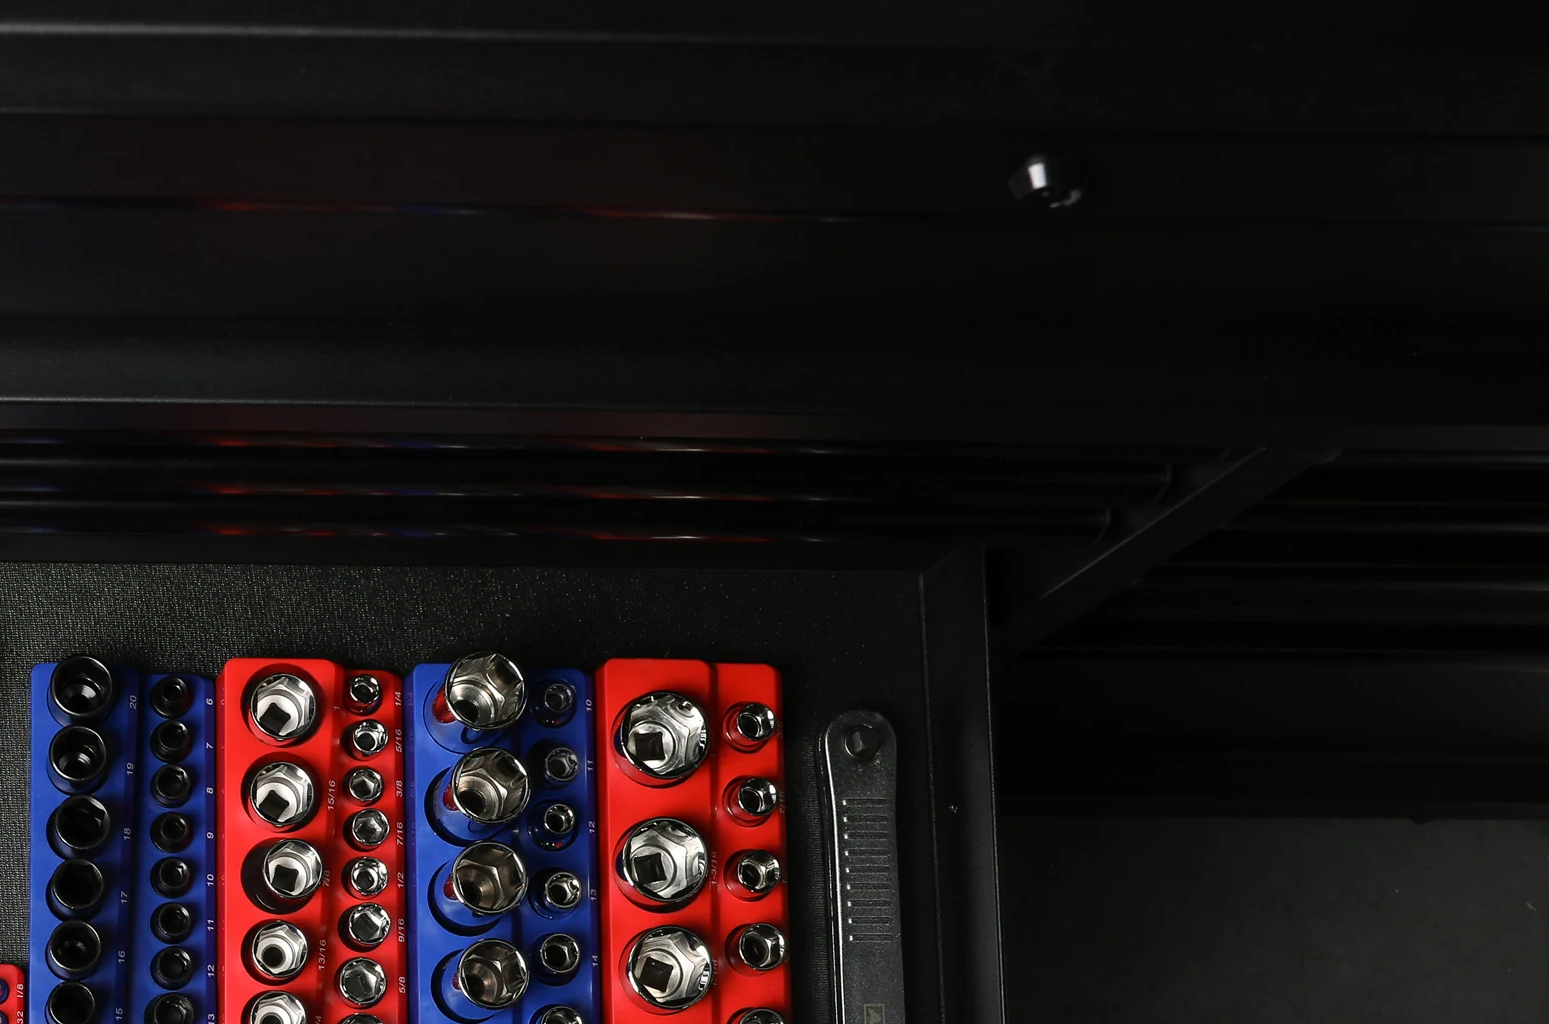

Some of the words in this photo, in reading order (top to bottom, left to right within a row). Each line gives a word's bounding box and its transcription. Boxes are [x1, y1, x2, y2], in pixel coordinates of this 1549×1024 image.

[130, 695, 137, 710] 20
[395, 729, 403, 753] 5/16
[127, 763, 134, 776] 19
[328, 781, 336, 811] 15/16
[124, 828, 131, 841] 18
[396, 823, 404, 846] 7/16
[207, 874, 215, 887] 10
[120, 891, 128, 904] 17
[207, 920, 215, 931] 11
[118, 951, 126, 963] 16
[318, 939, 326, 970] 13/16
[207, 965, 215, 977] 12
[115, 1008, 123, 1021] 15
